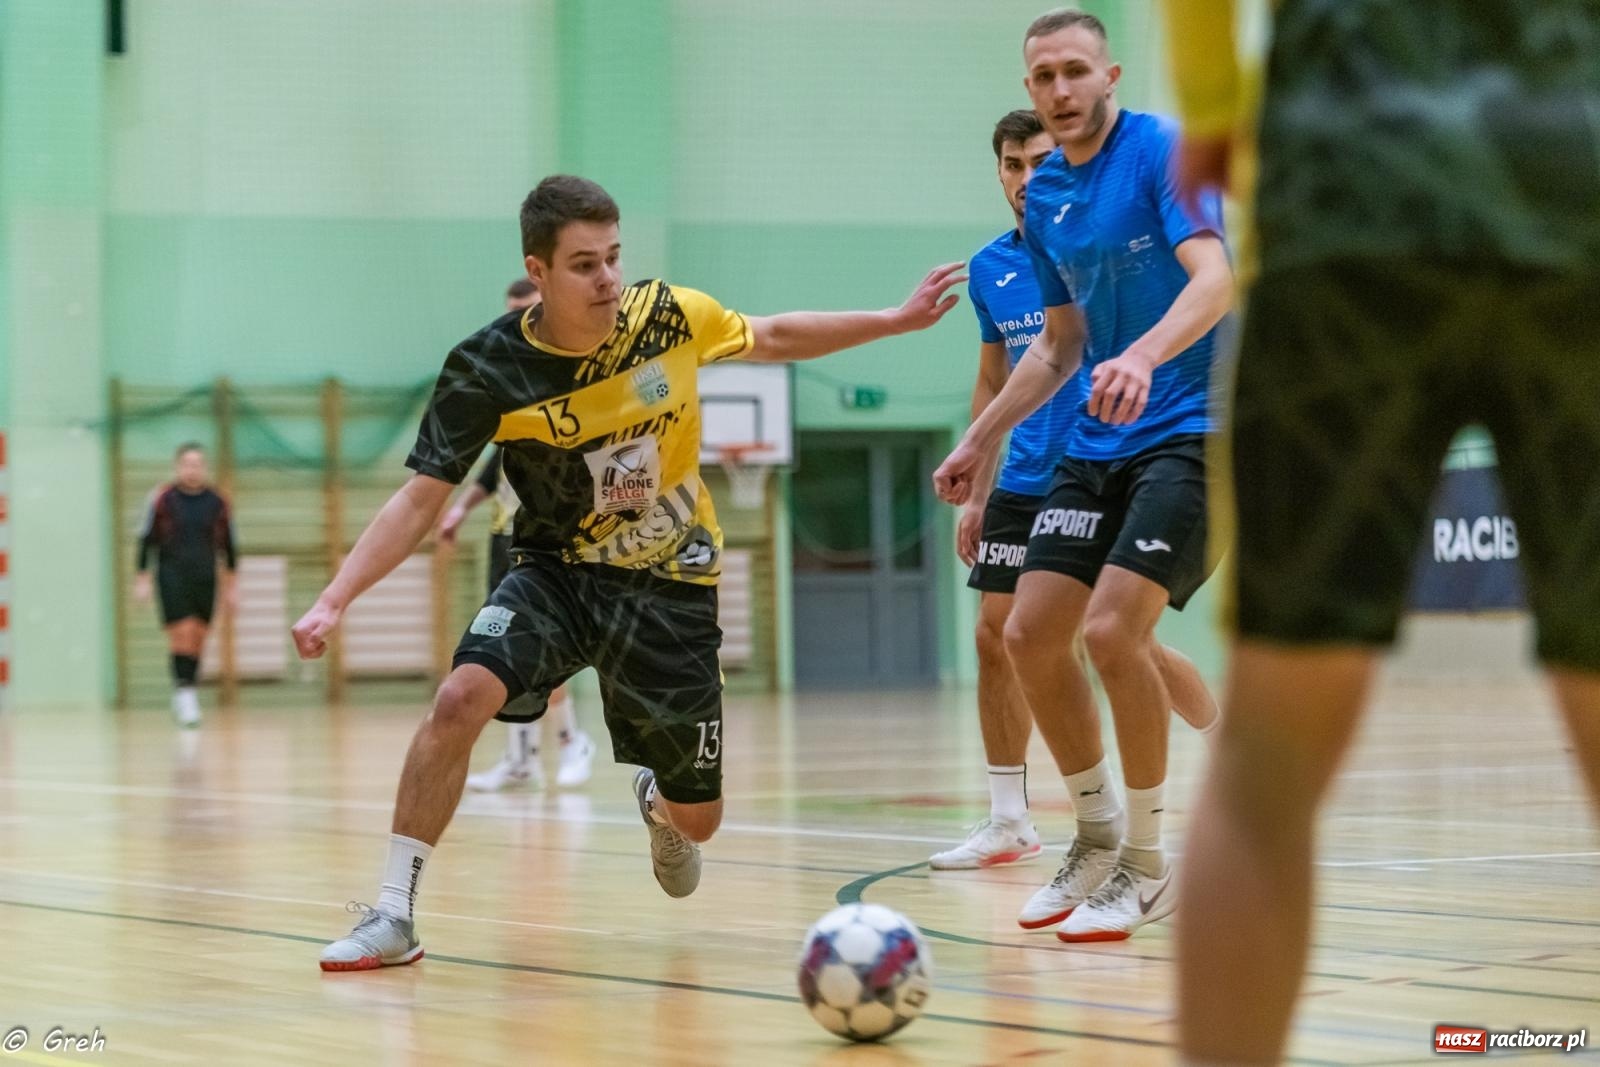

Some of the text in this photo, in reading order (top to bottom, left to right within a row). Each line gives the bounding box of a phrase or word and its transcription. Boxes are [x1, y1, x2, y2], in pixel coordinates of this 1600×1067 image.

[537, 397, 581, 440] 13
[1040, 508, 1103, 539] SPORT
[1433, 516, 1520, 562] RACIB
[696, 720, 720, 760] 13
